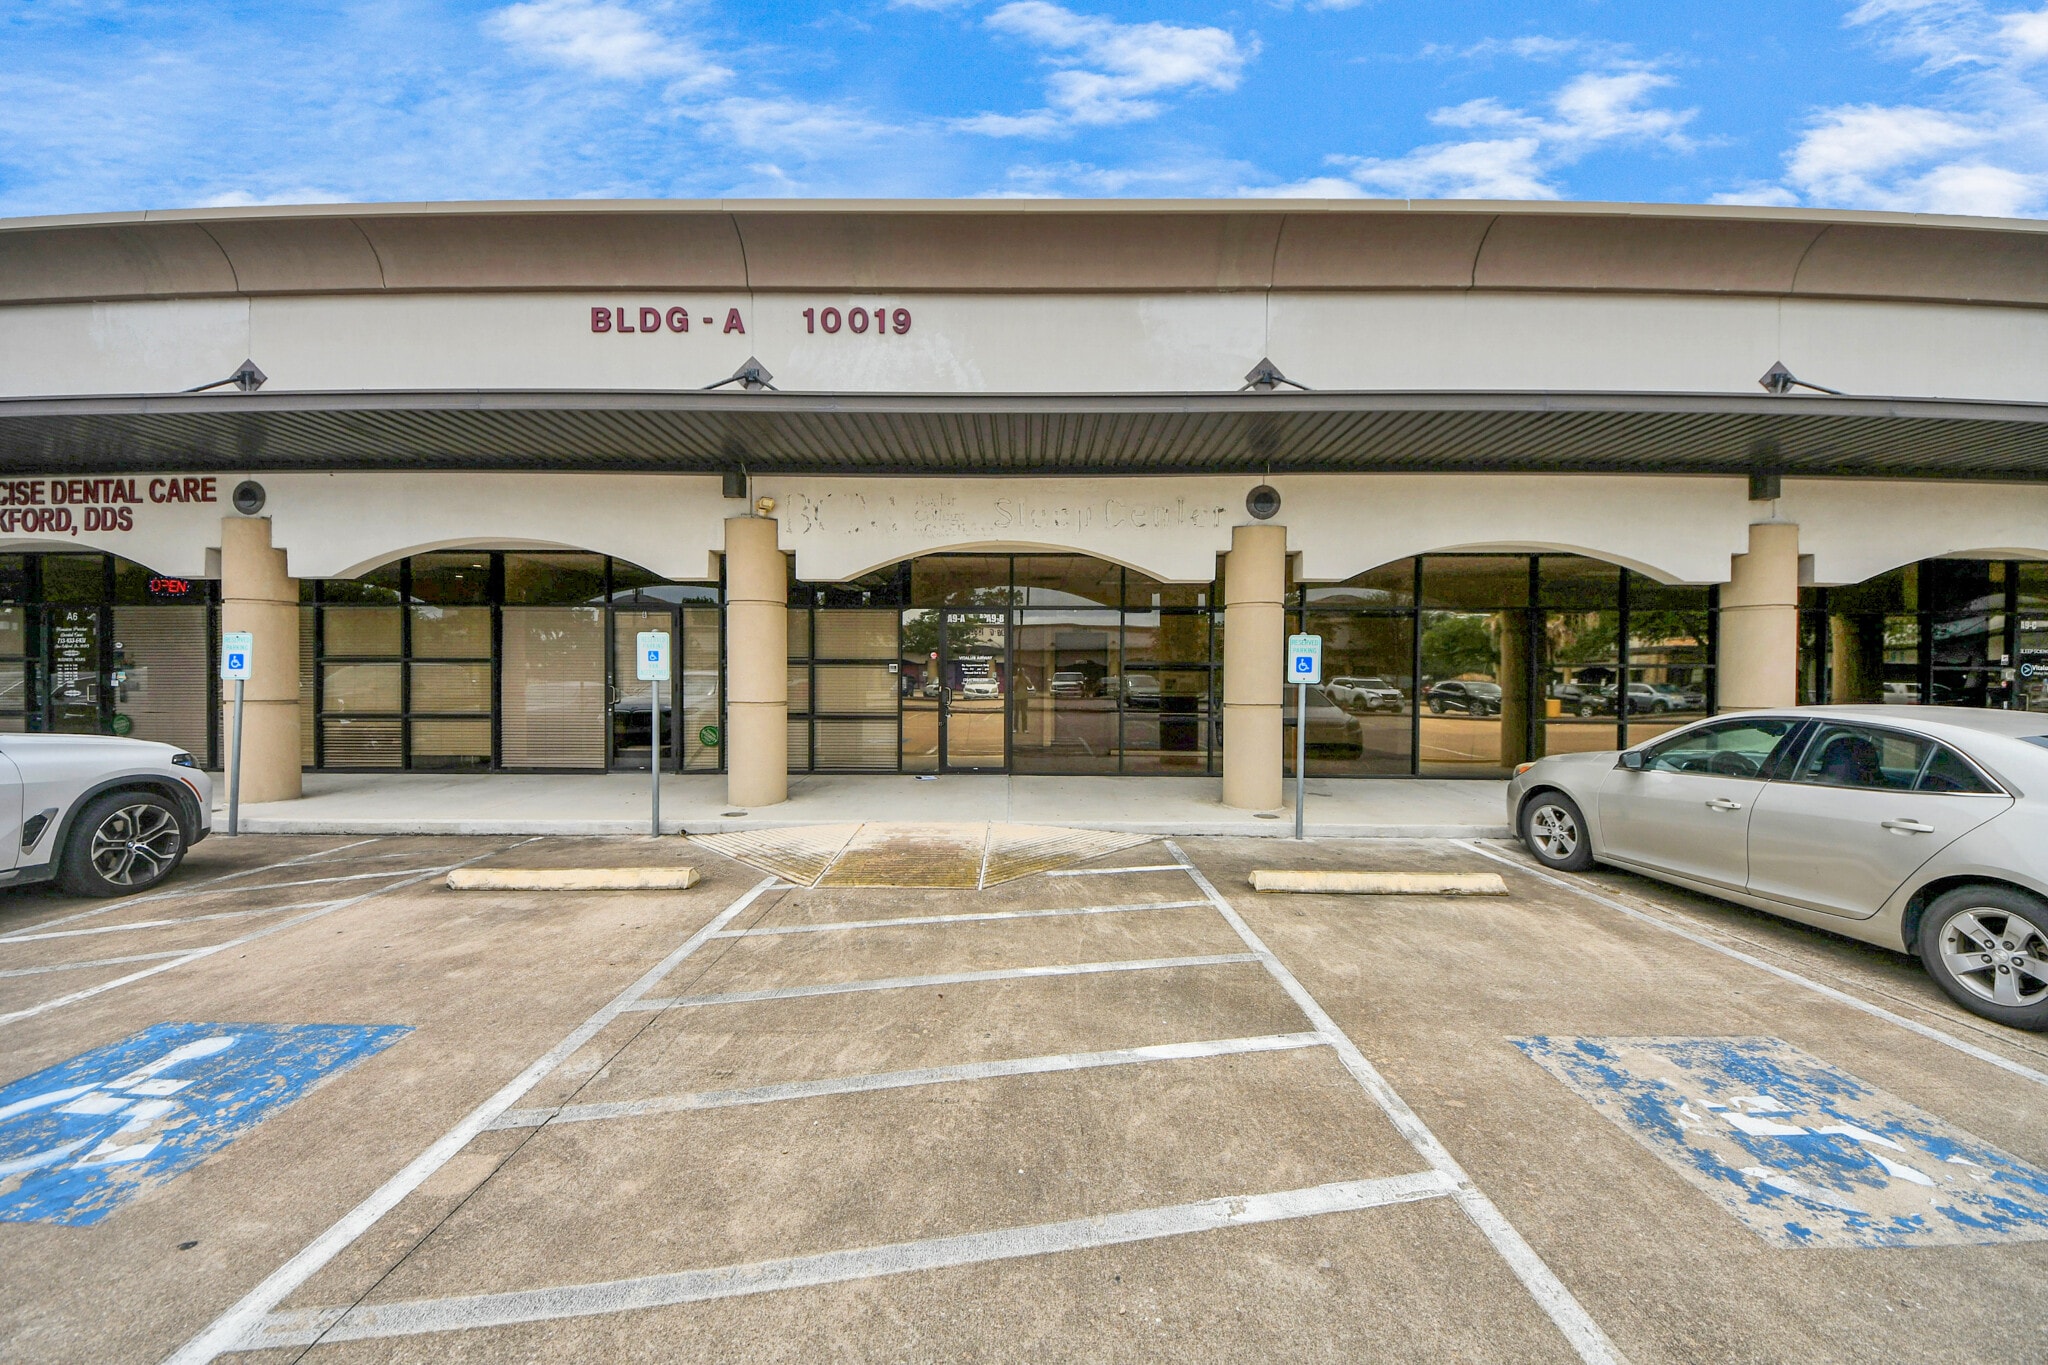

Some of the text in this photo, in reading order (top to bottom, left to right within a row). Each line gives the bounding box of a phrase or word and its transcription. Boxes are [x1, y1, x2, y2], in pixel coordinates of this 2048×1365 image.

[591, 306, 689, 333] BLDG
[723, 307, 746, 334] A
[802, 307, 912, 335] 10019
[51, 479, 144, 505] DENTAL
[149, 477, 217, 504] CARE
[84, 506, 133, 532] DDS
[151, 578, 188, 593] OPEN
[66, 612, 78, 621] A6
[947, 614, 965, 622] A9-A
[986, 614, 1004, 622] A9-B
